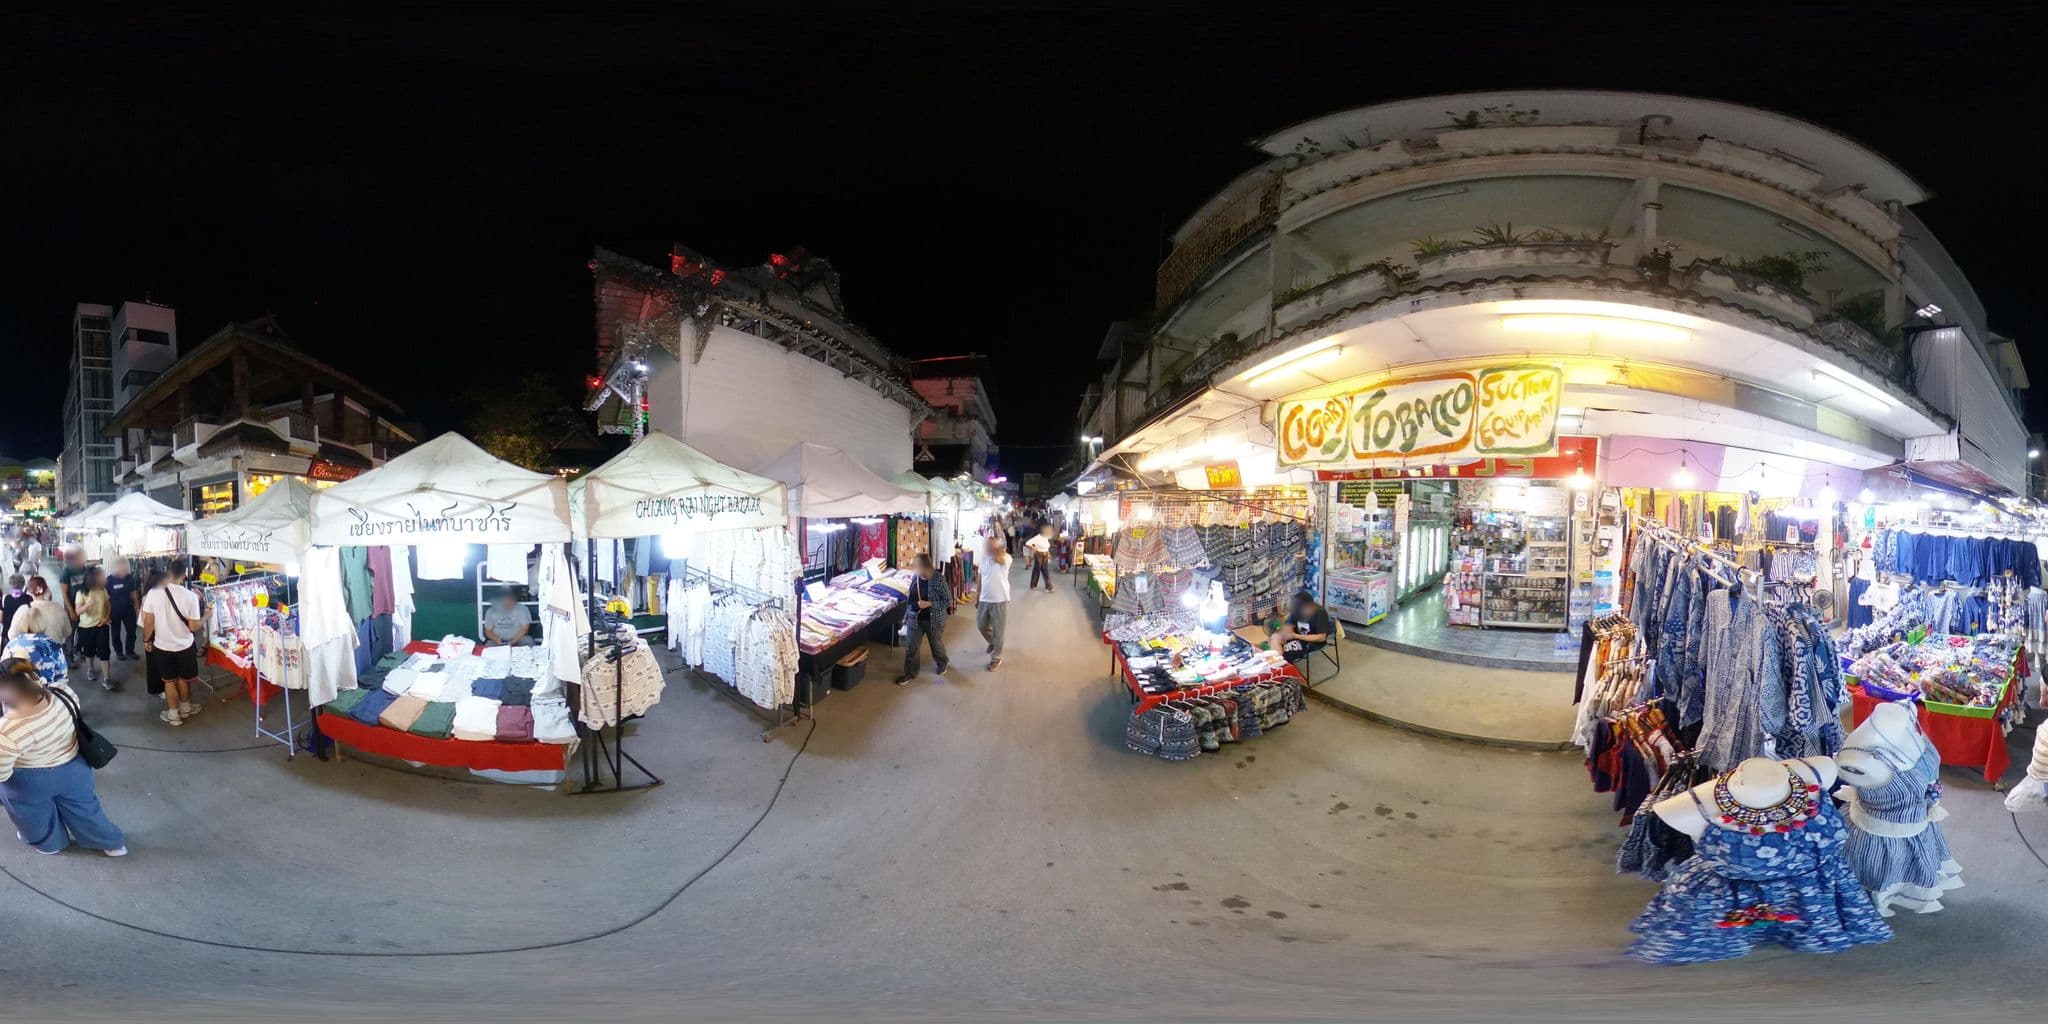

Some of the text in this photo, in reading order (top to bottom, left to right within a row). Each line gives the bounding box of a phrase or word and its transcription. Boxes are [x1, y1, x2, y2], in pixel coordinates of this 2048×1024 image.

[1482, 371, 1554, 408] SUCTION
[1353, 383, 1474, 453] TOBACCO
[347, 500, 518, 537] เชียงรายไนท์บาซาร์
[635, 493, 765, 524] CHIANG RAI NIGHT BAZAAR
